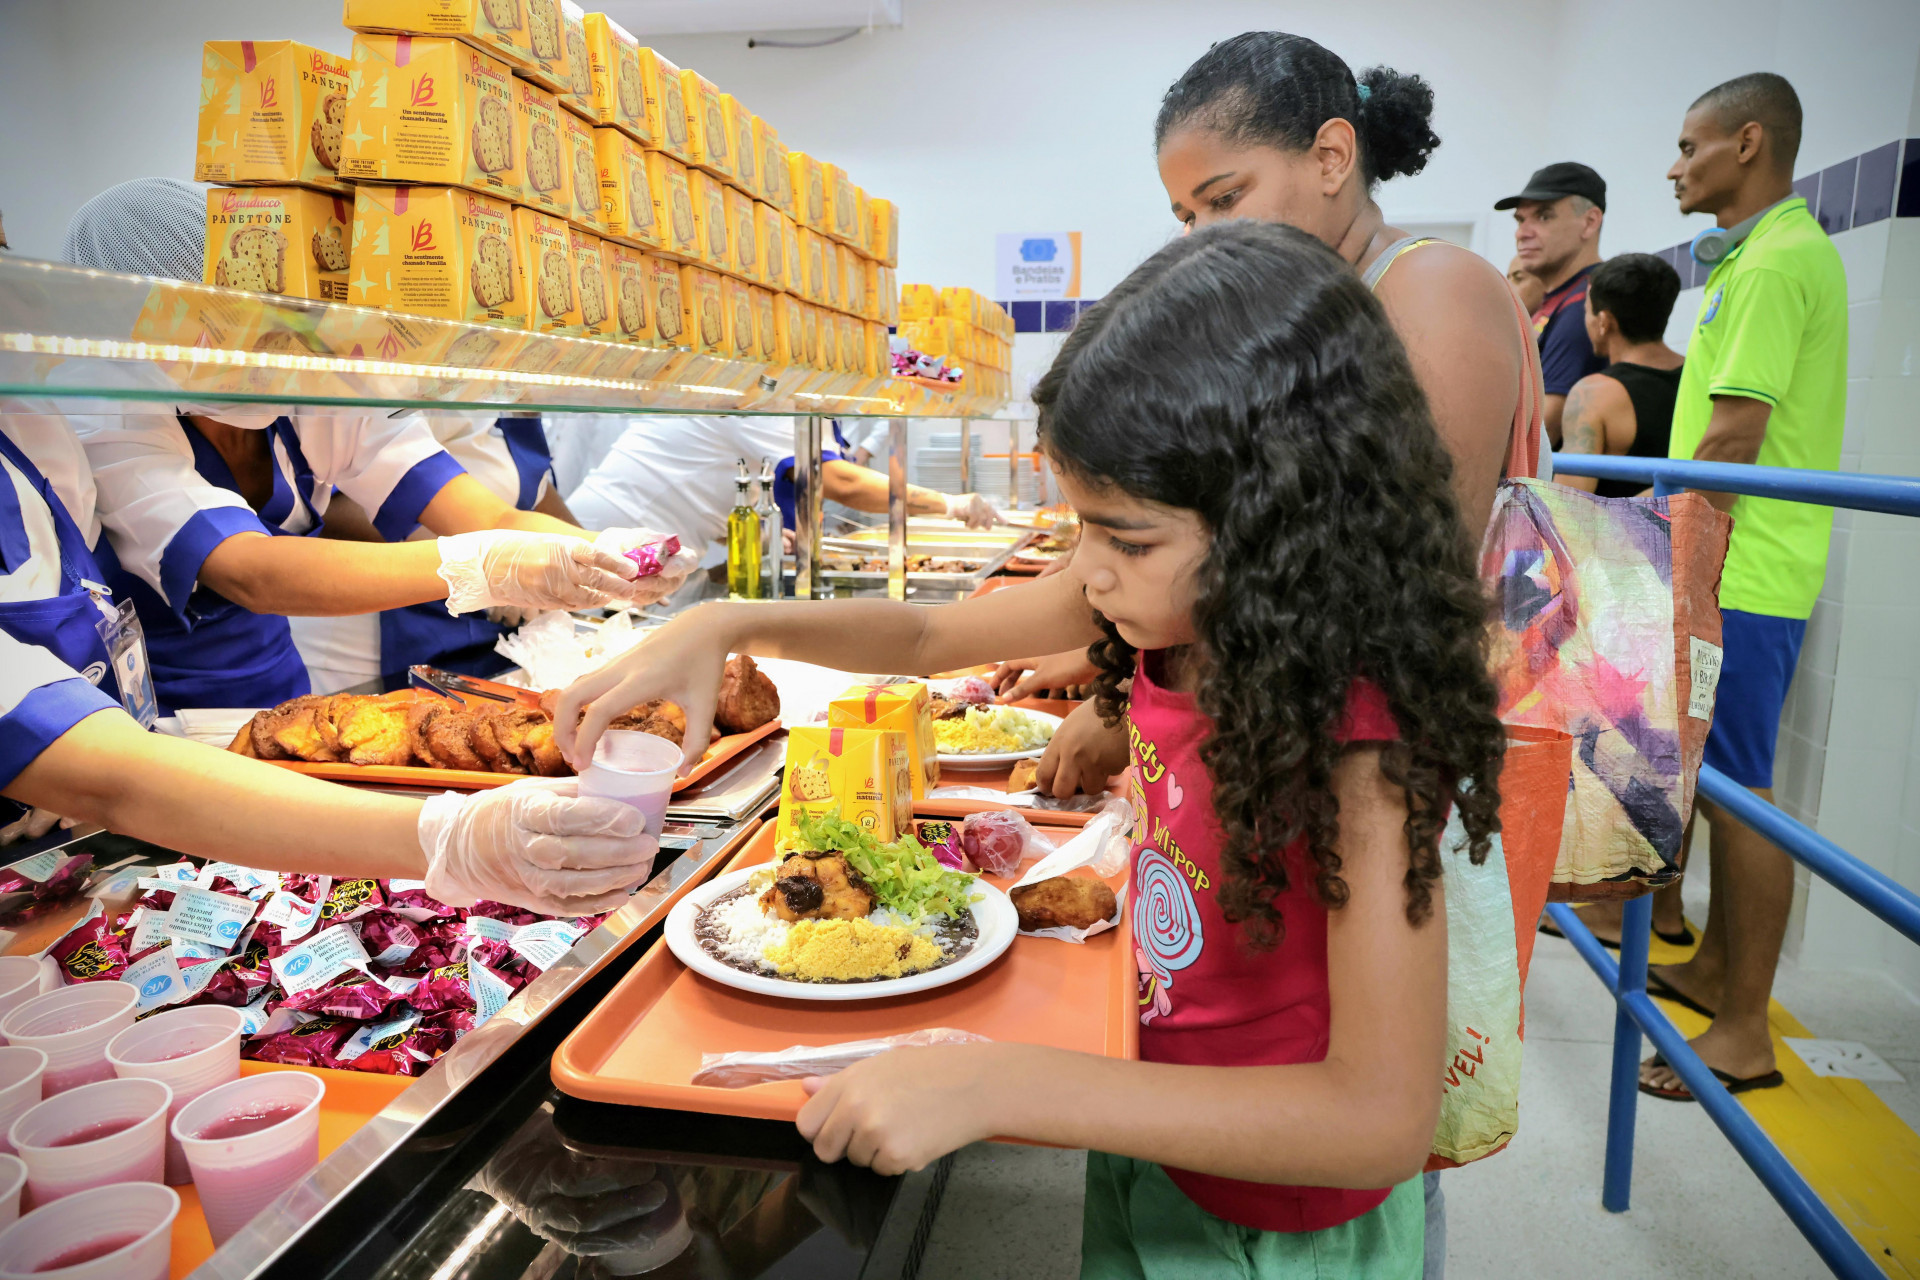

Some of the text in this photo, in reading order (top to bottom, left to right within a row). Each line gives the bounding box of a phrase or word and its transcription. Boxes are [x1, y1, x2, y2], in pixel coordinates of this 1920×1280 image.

[309, 50, 349, 78] Baudu
[469, 51, 506, 84] Bauducco
[303, 71, 348, 92] PANETT
[464, 73, 513, 103] PANETTONE
[522, 83, 553, 112] Bauducco
[412, 109, 446, 118] sentimento
[518, 102, 560, 129] PANETTONE
[221, 190, 282, 213] Bauducco
[465, 193, 505, 220] Bauducco
[212, 214, 292, 224] PANETTONE
[461, 215, 513, 237] PANETTONE
[1015, 275, 1061, 284] e Pratos
[1127, 713, 1166, 783] ndy
[179, 912, 195, 921] desta
[186, 906, 213, 916] parceria.
[168, 923, 186, 932] muito
[180, 919, 193, 927] com
[193, 920, 213, 931] felizes
[331, 928, 348, 939] muito
[313, 941, 332, 955] felizes
[331, 935, 343, 944] com
[324, 946, 351, 962] parceria.
[335, 940, 350, 951] desta
[1444, 1026, 1490, 1093] VEL!
